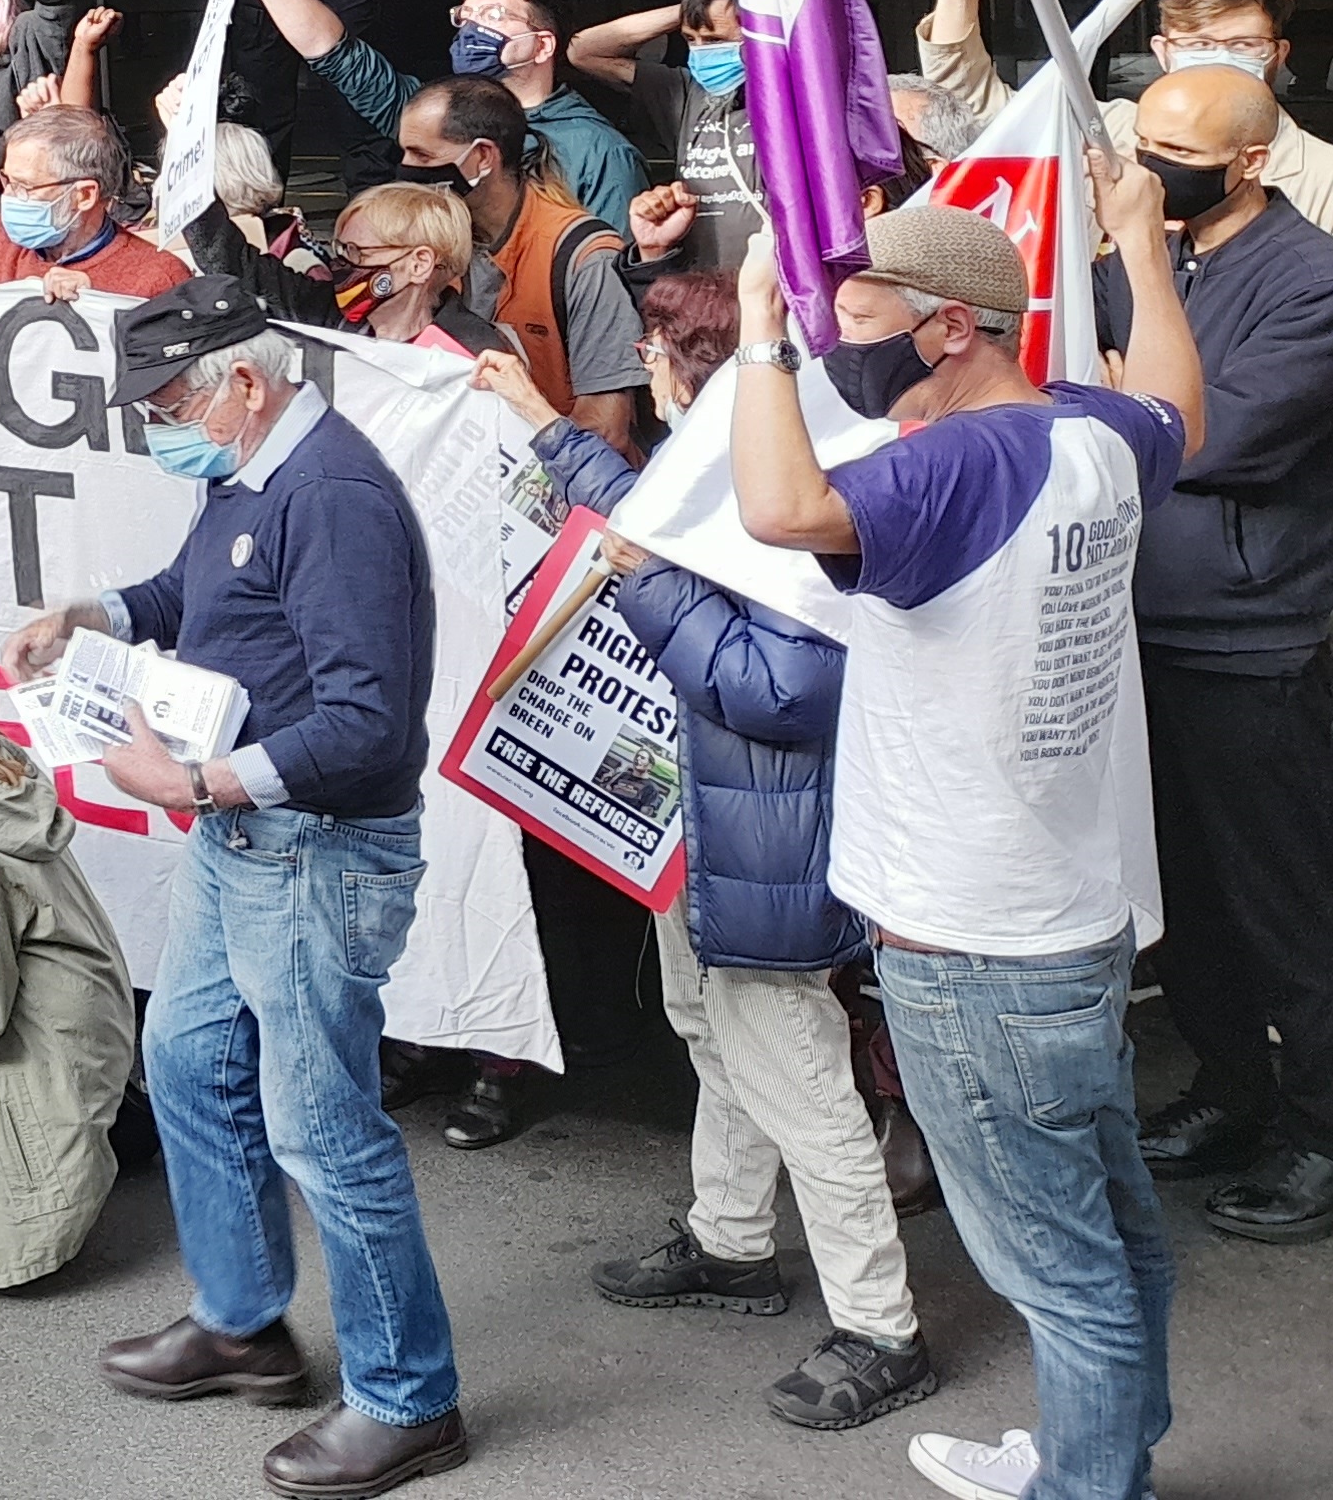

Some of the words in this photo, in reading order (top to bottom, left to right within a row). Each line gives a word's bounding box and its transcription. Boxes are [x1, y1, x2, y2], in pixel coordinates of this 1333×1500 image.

[166, 128, 206, 192] Crime!
[1047, 522, 1085, 574] 10
[1089, 518, 1118, 542] GOOD
[1087, 542, 1109, 566] NOT
[578, 615, 660, 683] RIGHT
[508, 704, 553, 739] BREEN
[518, 686, 570, 727] CHARGE
[575, 720, 596, 742] ON
[527, 670, 566, 698] DROP
[569, 693, 594, 718] THE
[560, 653, 678, 744] PROTEST
[492, 734, 534, 768] FREE
[537, 758, 568, 790] THE
[569, 777, 659, 850] REFUGEES
